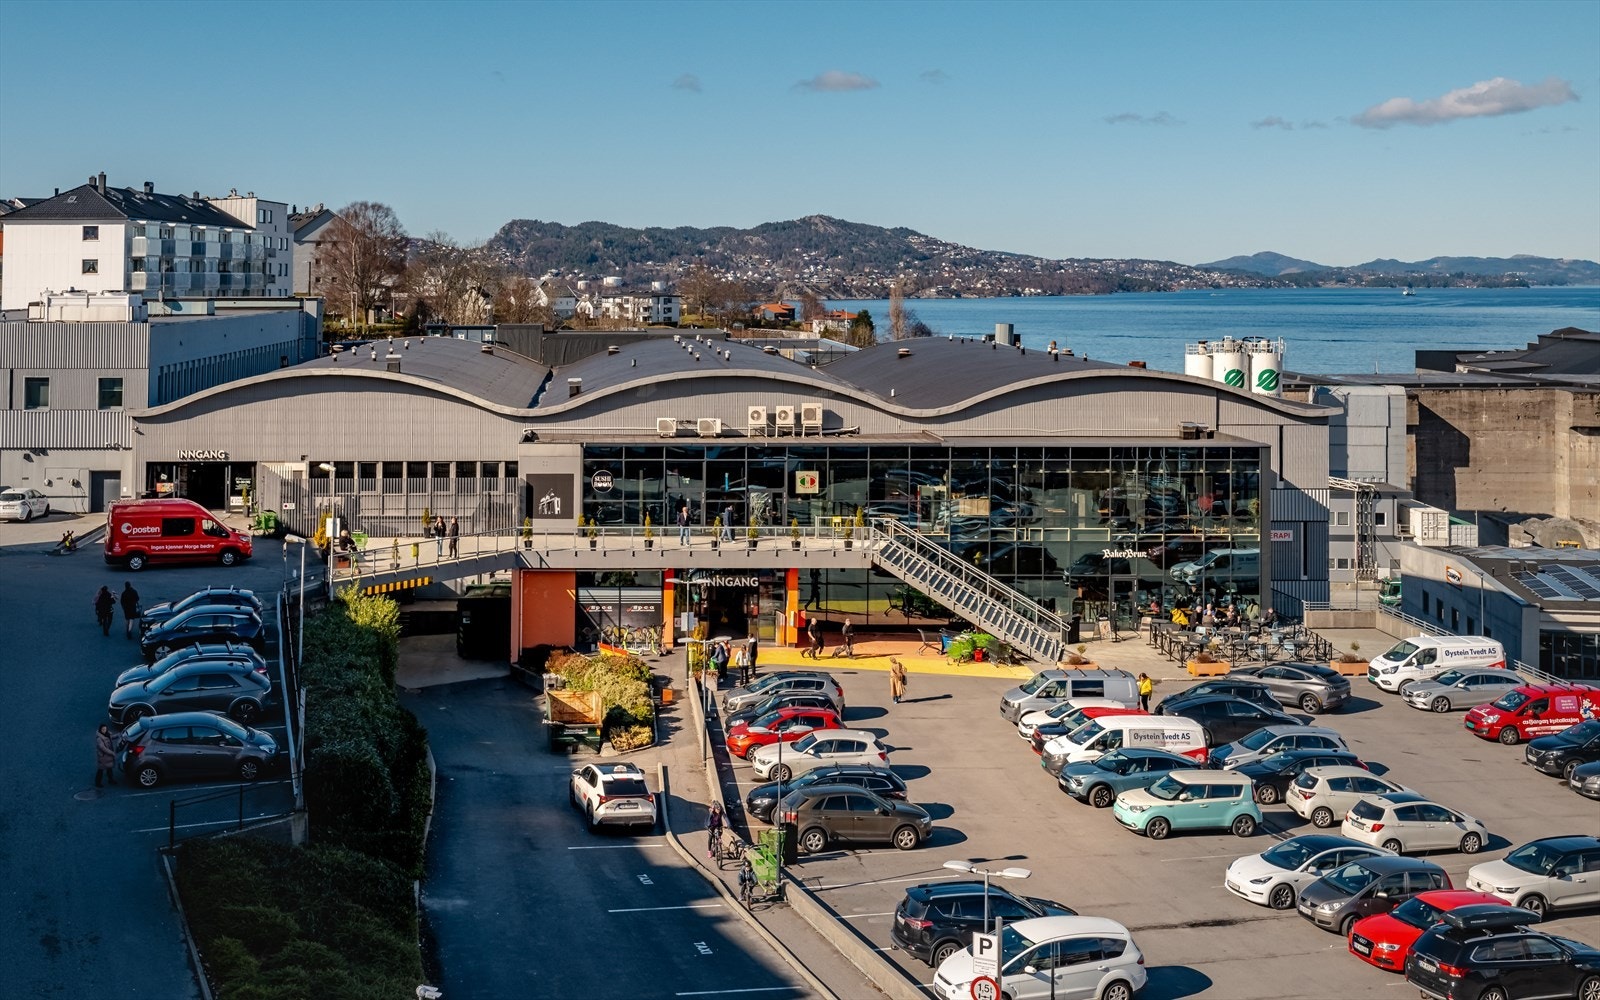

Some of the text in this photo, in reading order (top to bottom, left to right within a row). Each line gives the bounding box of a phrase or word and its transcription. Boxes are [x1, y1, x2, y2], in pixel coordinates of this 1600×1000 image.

[177, 449, 226, 459] INNGANG
[132, 526, 160, 535] posten
[703, 577, 759, 587] INNGANG
[1444, 649, 1469, 658] Øystein
[1487, 647, 1497, 655] AS
[1133, 732, 1191, 742] Øystein Tvedt AS
[636, 873, 654, 885] TAXI
[693, 941, 713, 955] TAXI
[979, 937, 993, 955] P
